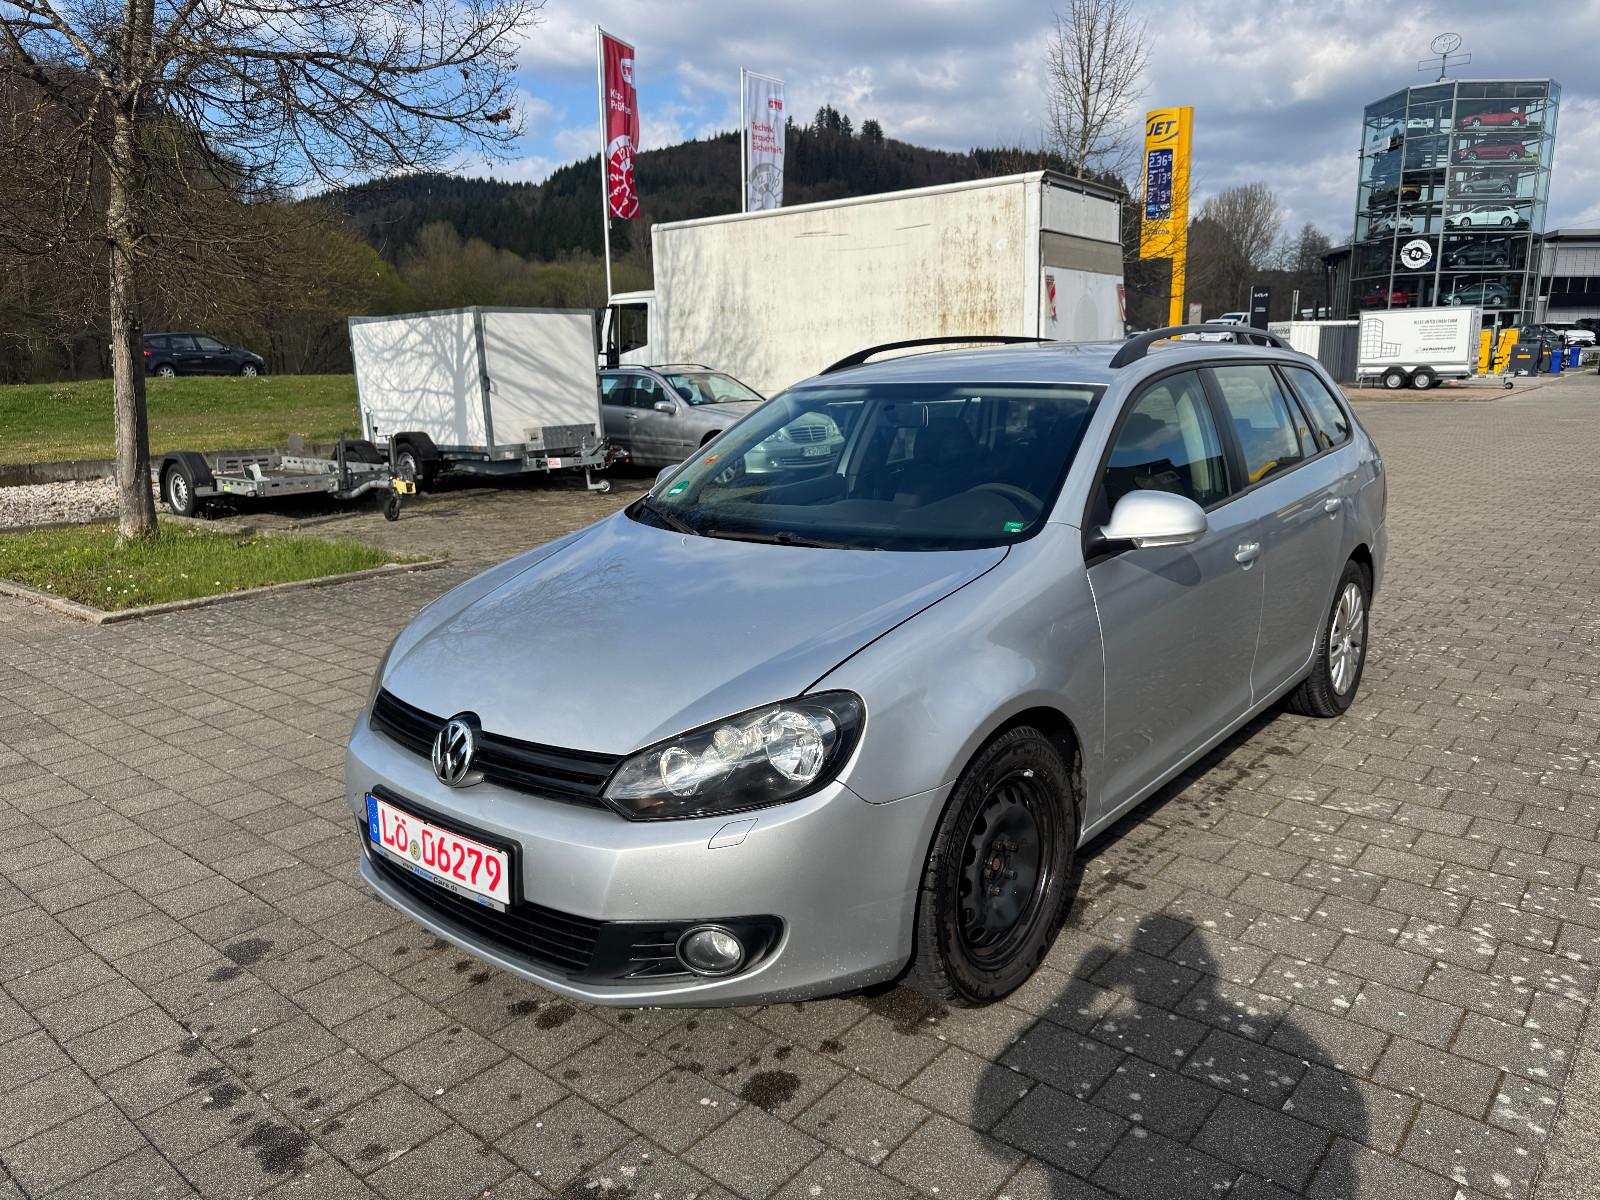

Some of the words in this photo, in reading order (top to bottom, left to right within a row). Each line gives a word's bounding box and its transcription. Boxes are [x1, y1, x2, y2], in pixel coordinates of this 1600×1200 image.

[1146, 120, 1177, 137] JET
[381, 808, 408, 852] LÖ
[421, 829, 502, 892] 06279
